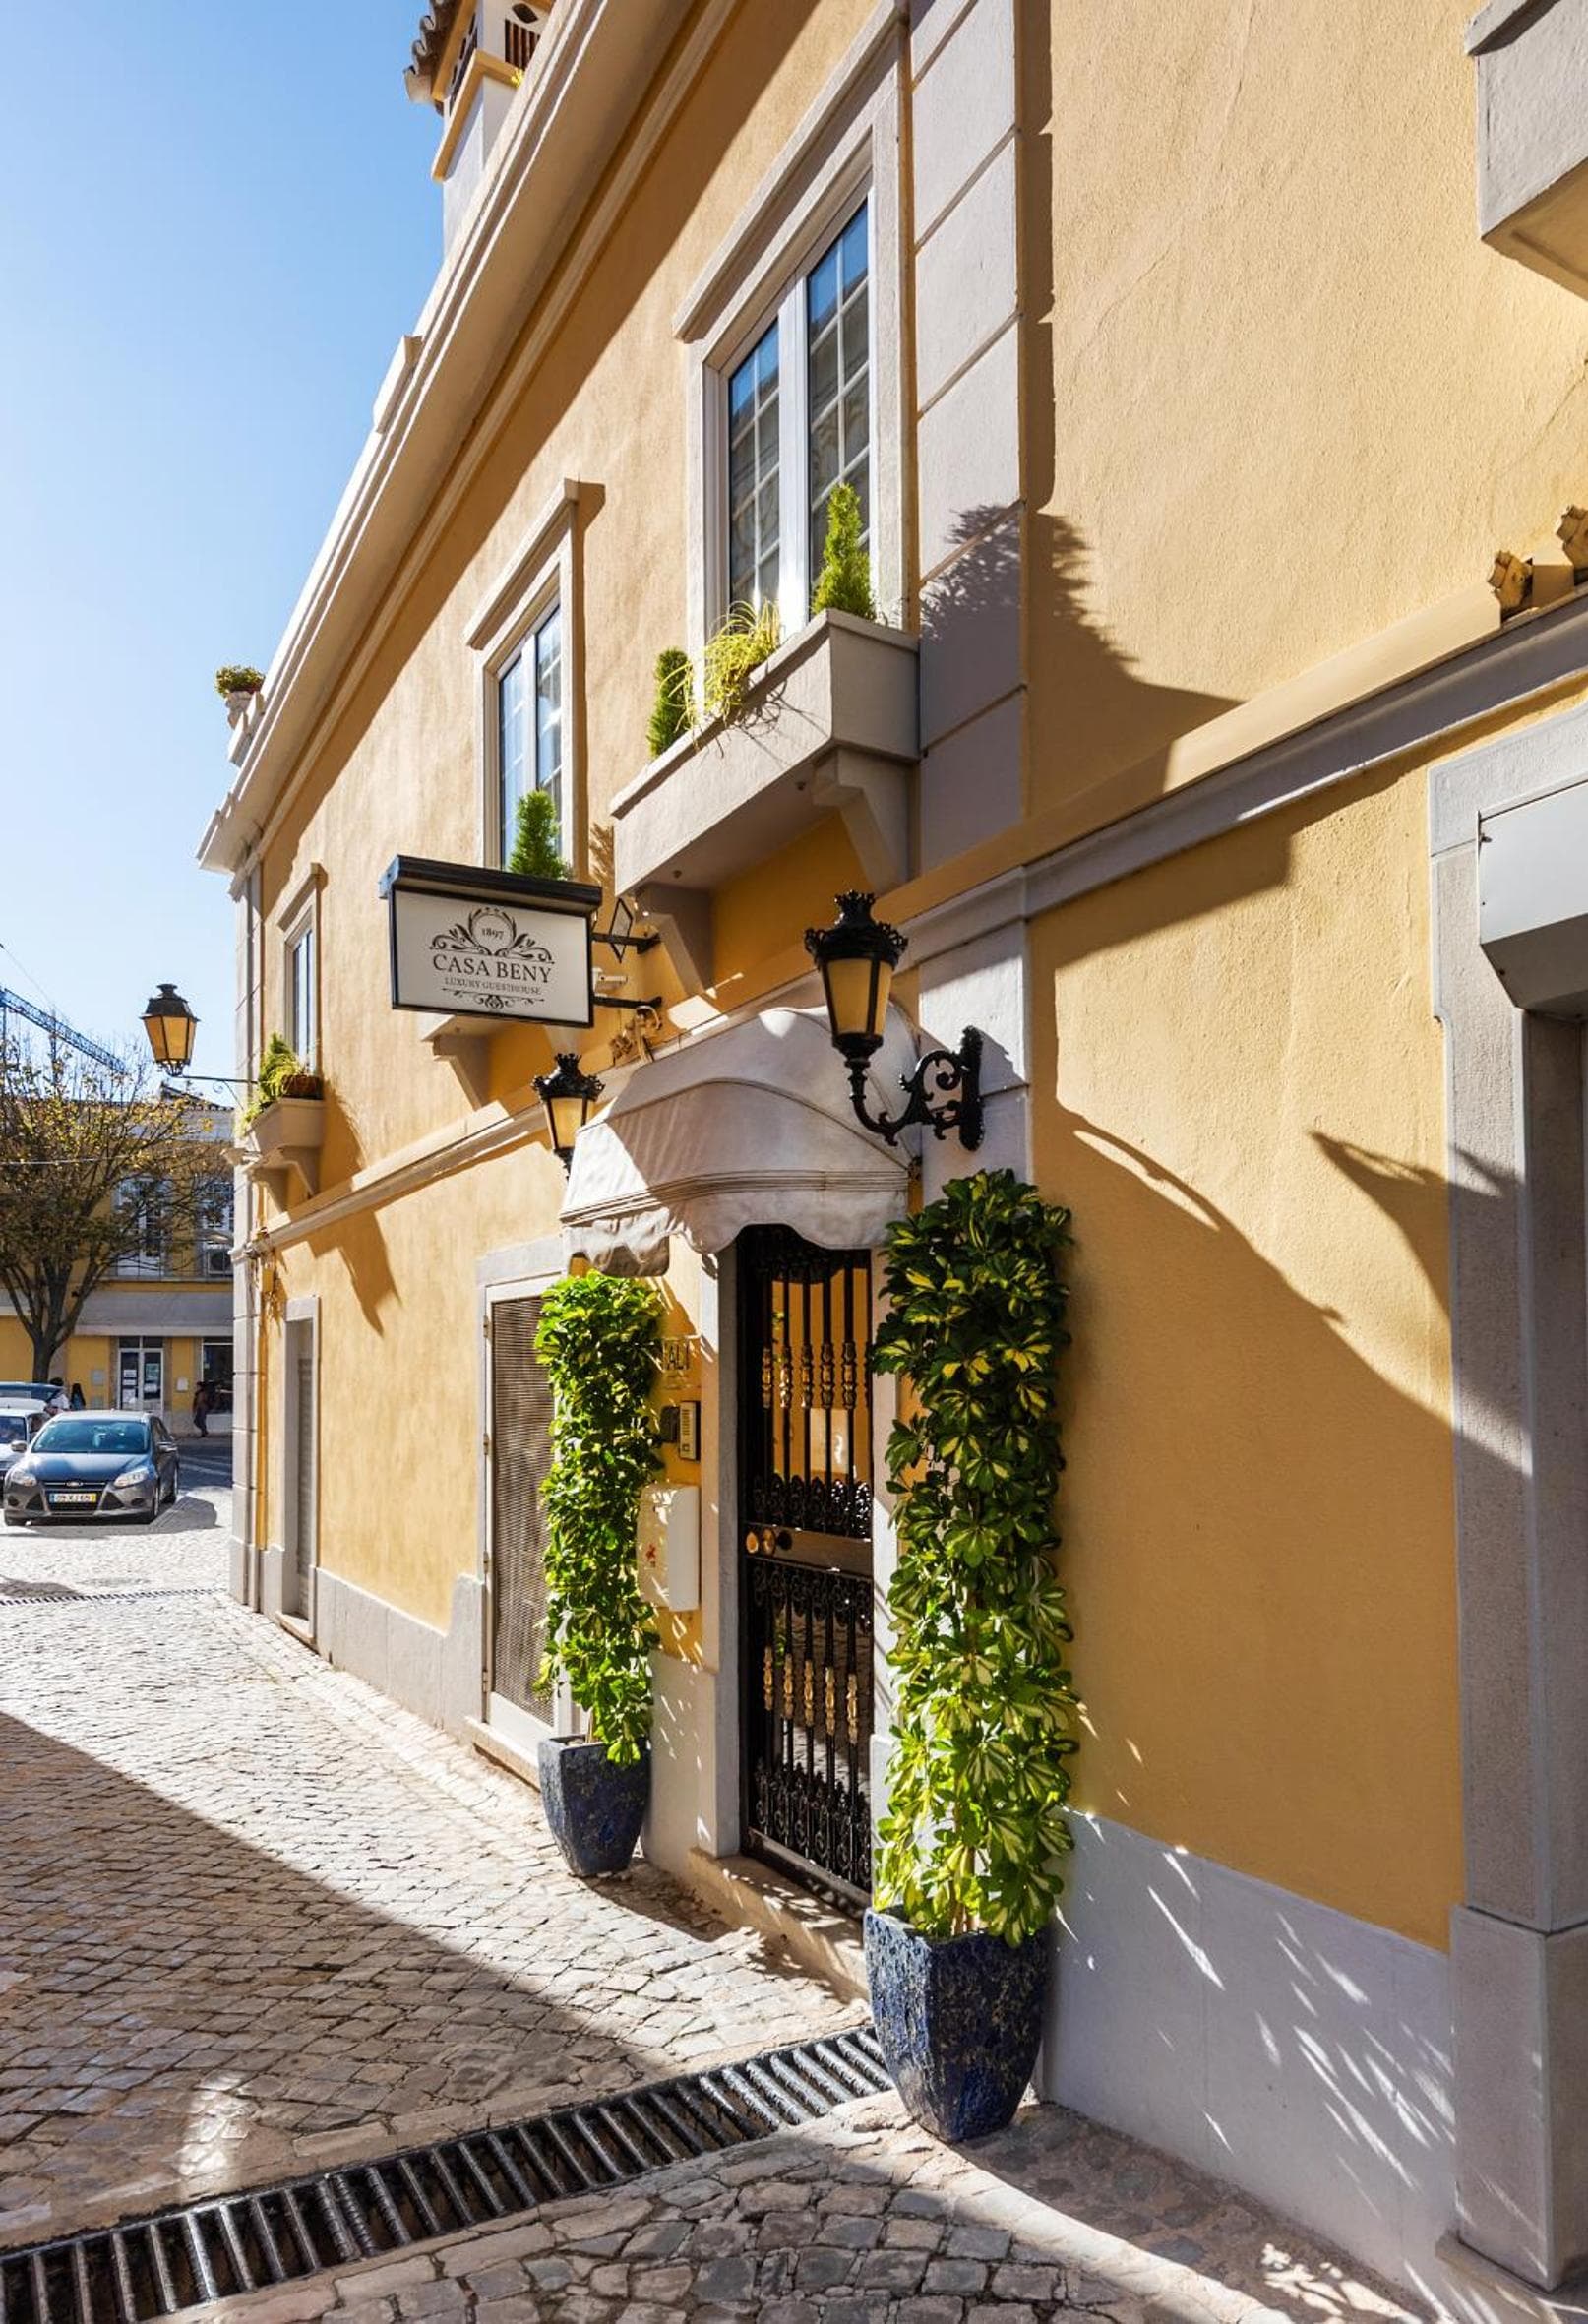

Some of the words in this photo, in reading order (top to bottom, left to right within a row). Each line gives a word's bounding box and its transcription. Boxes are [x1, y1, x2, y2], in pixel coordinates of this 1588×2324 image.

[482, 928, 504, 940] 1897
[433, 953, 490, 976] CASA
[496, 961, 551, 983] BENY
[445, 977, 481, 988] LUXURY
[482, 981, 541, 995] GUESTHOUSE
